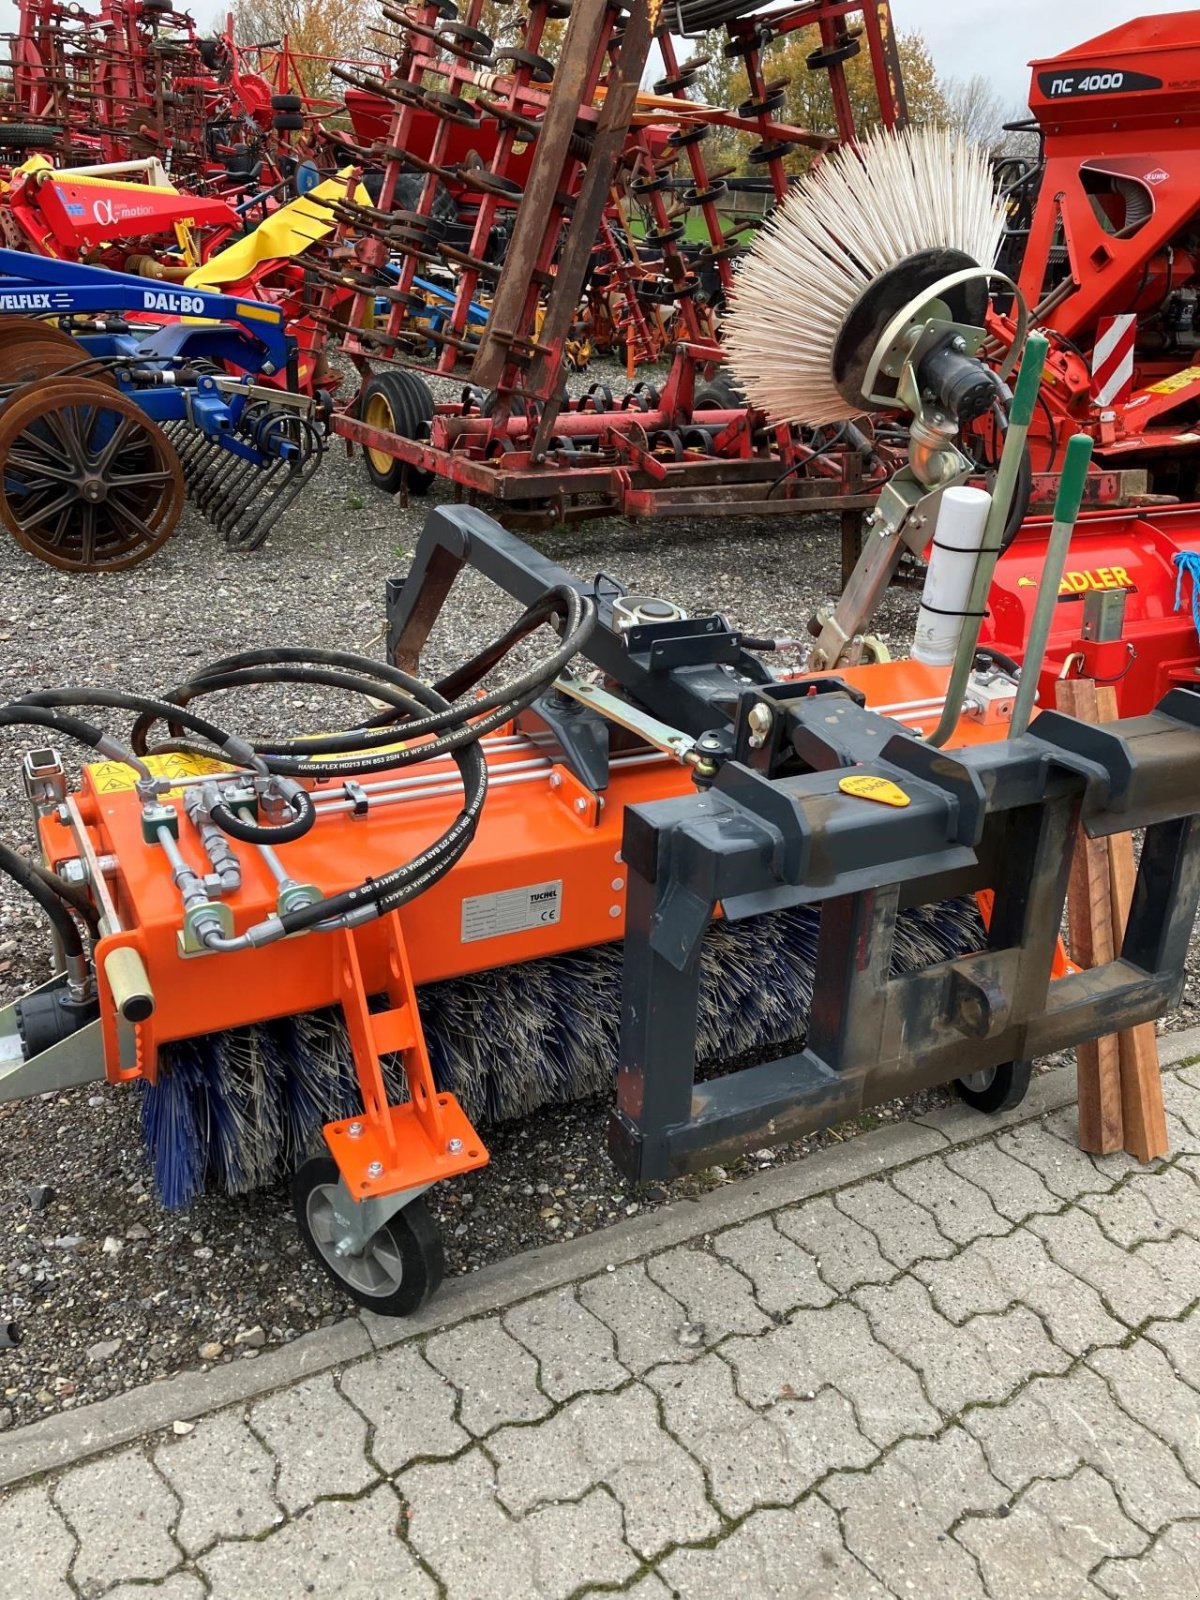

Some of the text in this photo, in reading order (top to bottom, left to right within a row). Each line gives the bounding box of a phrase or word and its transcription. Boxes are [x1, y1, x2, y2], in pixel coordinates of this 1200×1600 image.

[1077, 72, 1124, 91] 4000
[1057, 566, 1134, 594] ADLER
[339, 761, 361, 769] HD213
[373, 757, 385, 765] 853
[386, 754, 400, 762] 2SN
[411, 747, 422, 755] WP
[423, 742, 436, 752] 275
[436, 736, 452, 747] BAR
[452, 728, 473, 741] MSHA
[425, 846, 441, 859] BAR
[406, 856, 428, 871] MSHA
[530, 889, 557, 902] TUCHEL
